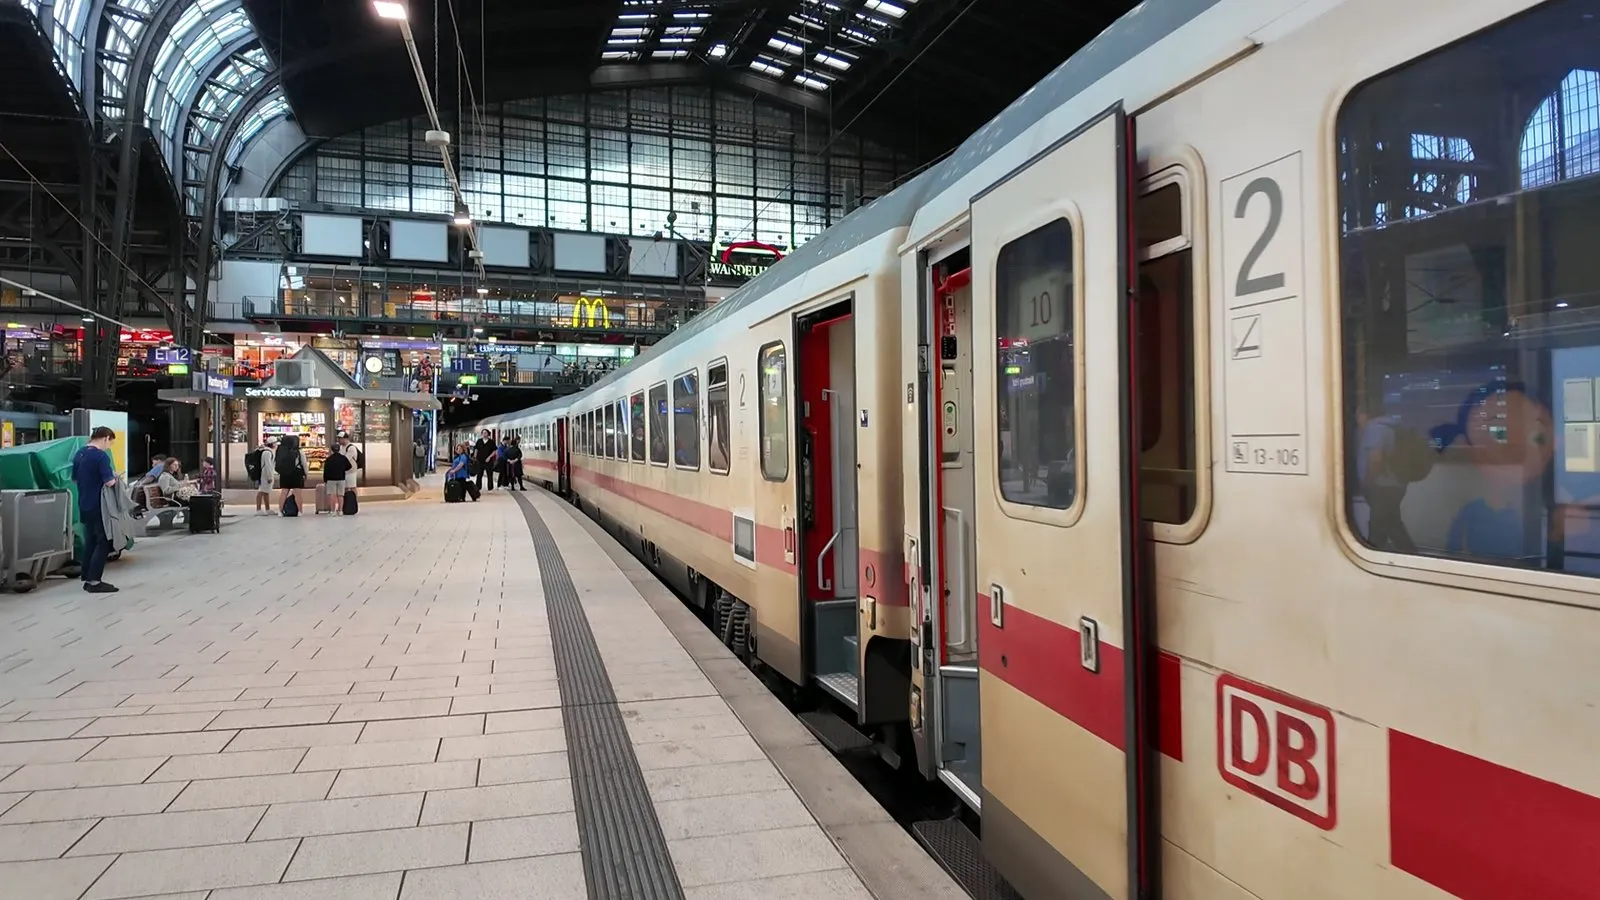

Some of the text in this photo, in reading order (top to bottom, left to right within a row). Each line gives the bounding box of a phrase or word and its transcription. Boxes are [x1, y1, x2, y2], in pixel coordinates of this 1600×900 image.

[1234, 176, 1286, 297] 2
[1029, 290, 1052, 327] 10
[155, 348, 189, 361] E 12
[452, 359, 482, 371] 11 E
[245, 387, 307, 397] ServiceStore
[739, 373, 746, 407] 2
[1230, 694, 1320, 801] DB
